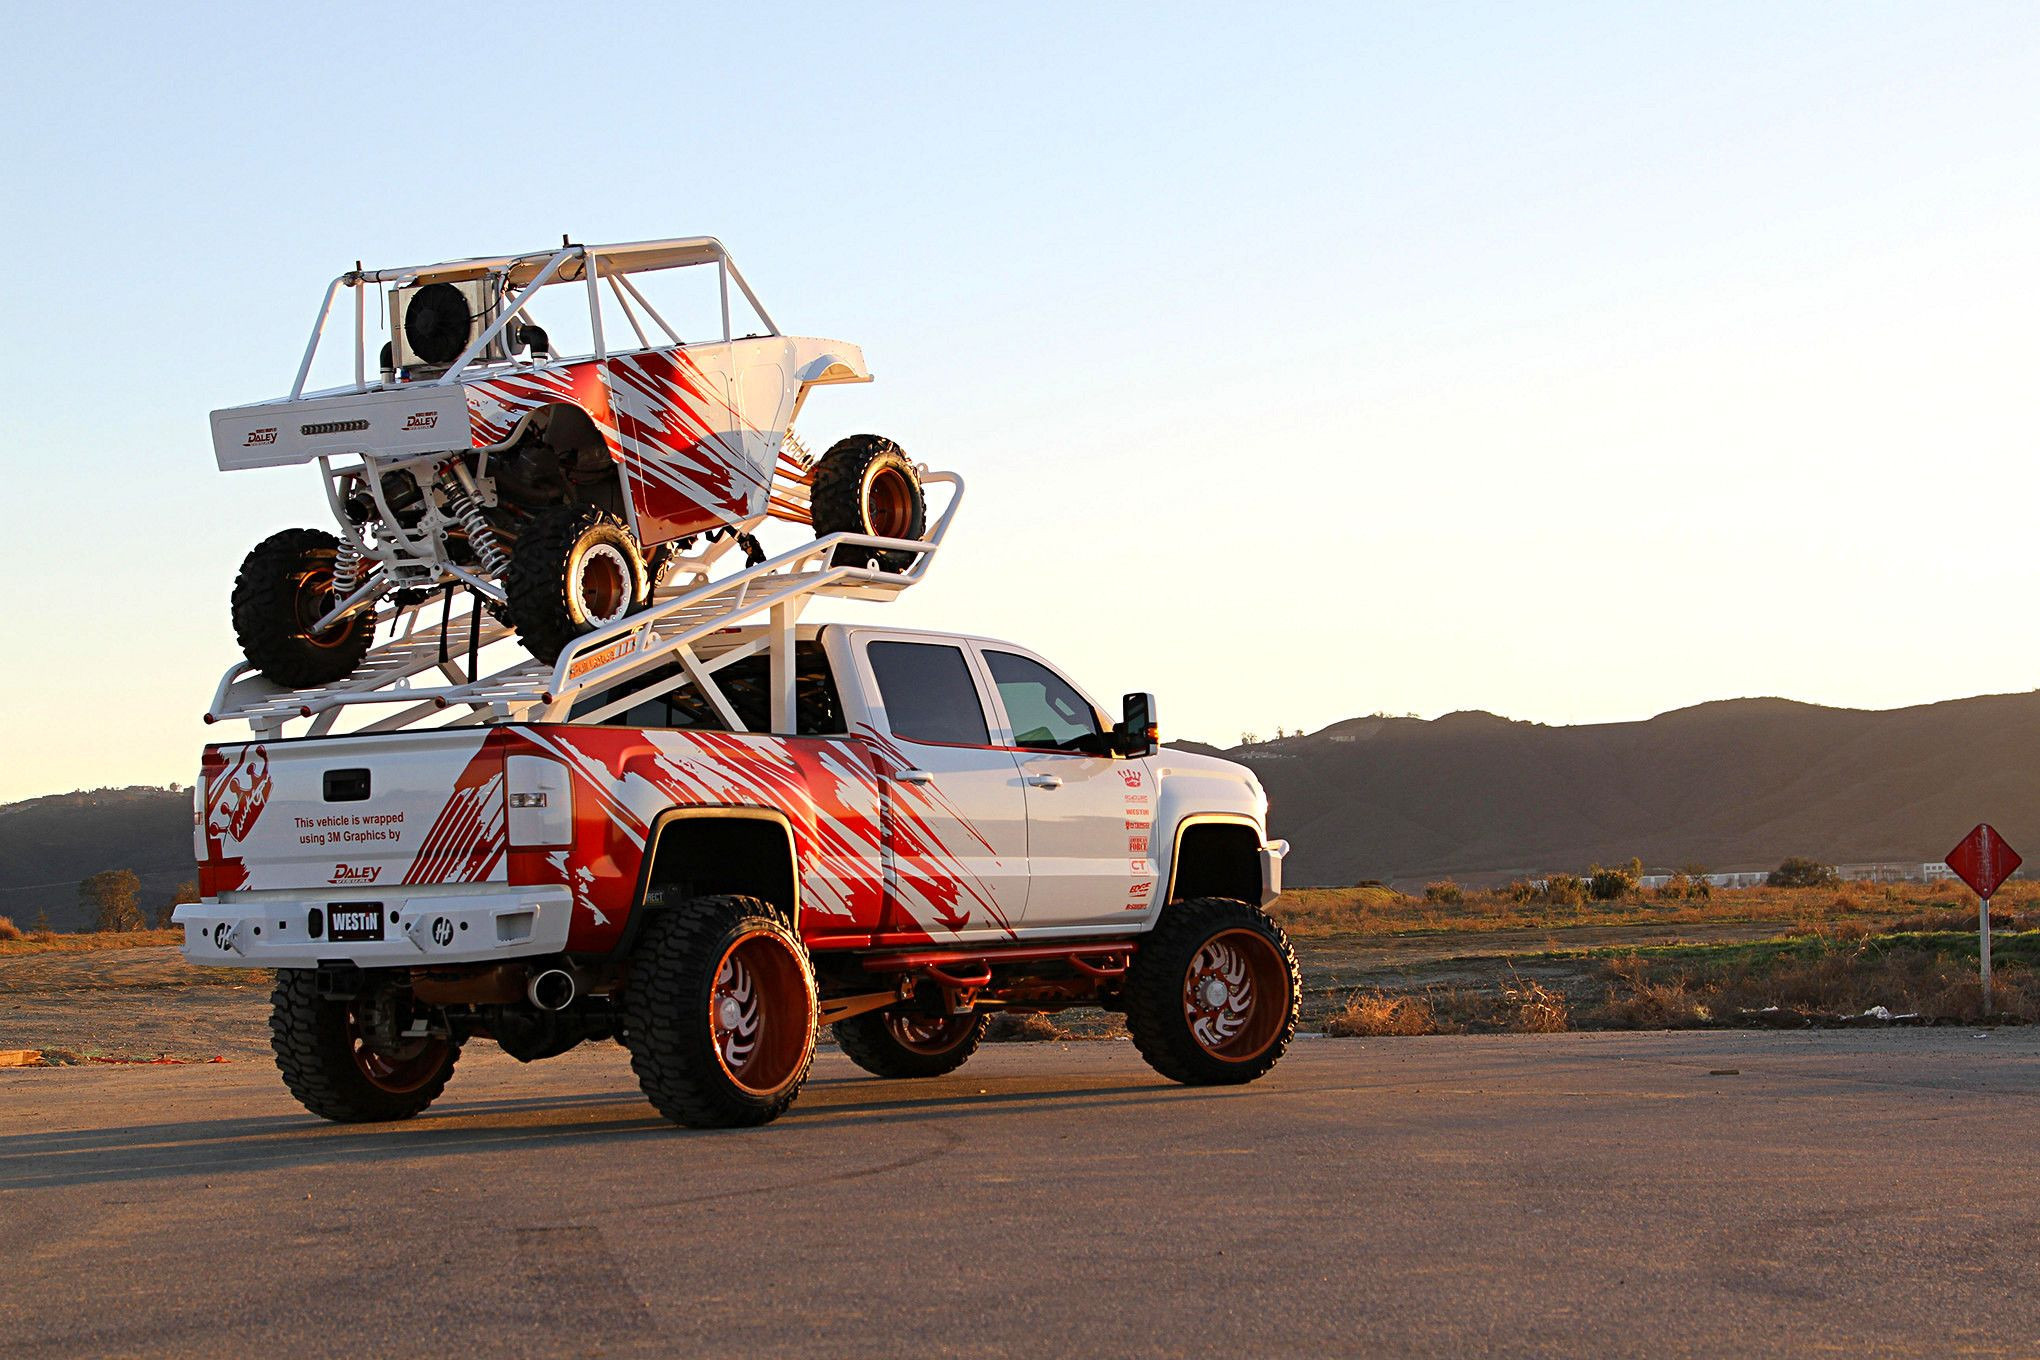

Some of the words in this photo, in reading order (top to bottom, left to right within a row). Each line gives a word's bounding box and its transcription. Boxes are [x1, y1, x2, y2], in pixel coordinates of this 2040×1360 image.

[294, 817, 315, 828] This
[316, 815, 349, 827] vehicle
[352, 815, 360, 825] is
[362, 812, 404, 826] wrapped
[300, 834, 325, 845] using
[328, 832, 341, 842] 3M
[343, 830, 386, 843] Graphics
[389, 829, 401, 841] by
[1131, 860, 1146, 870] CT
[333, 864, 382, 883] DALEY
